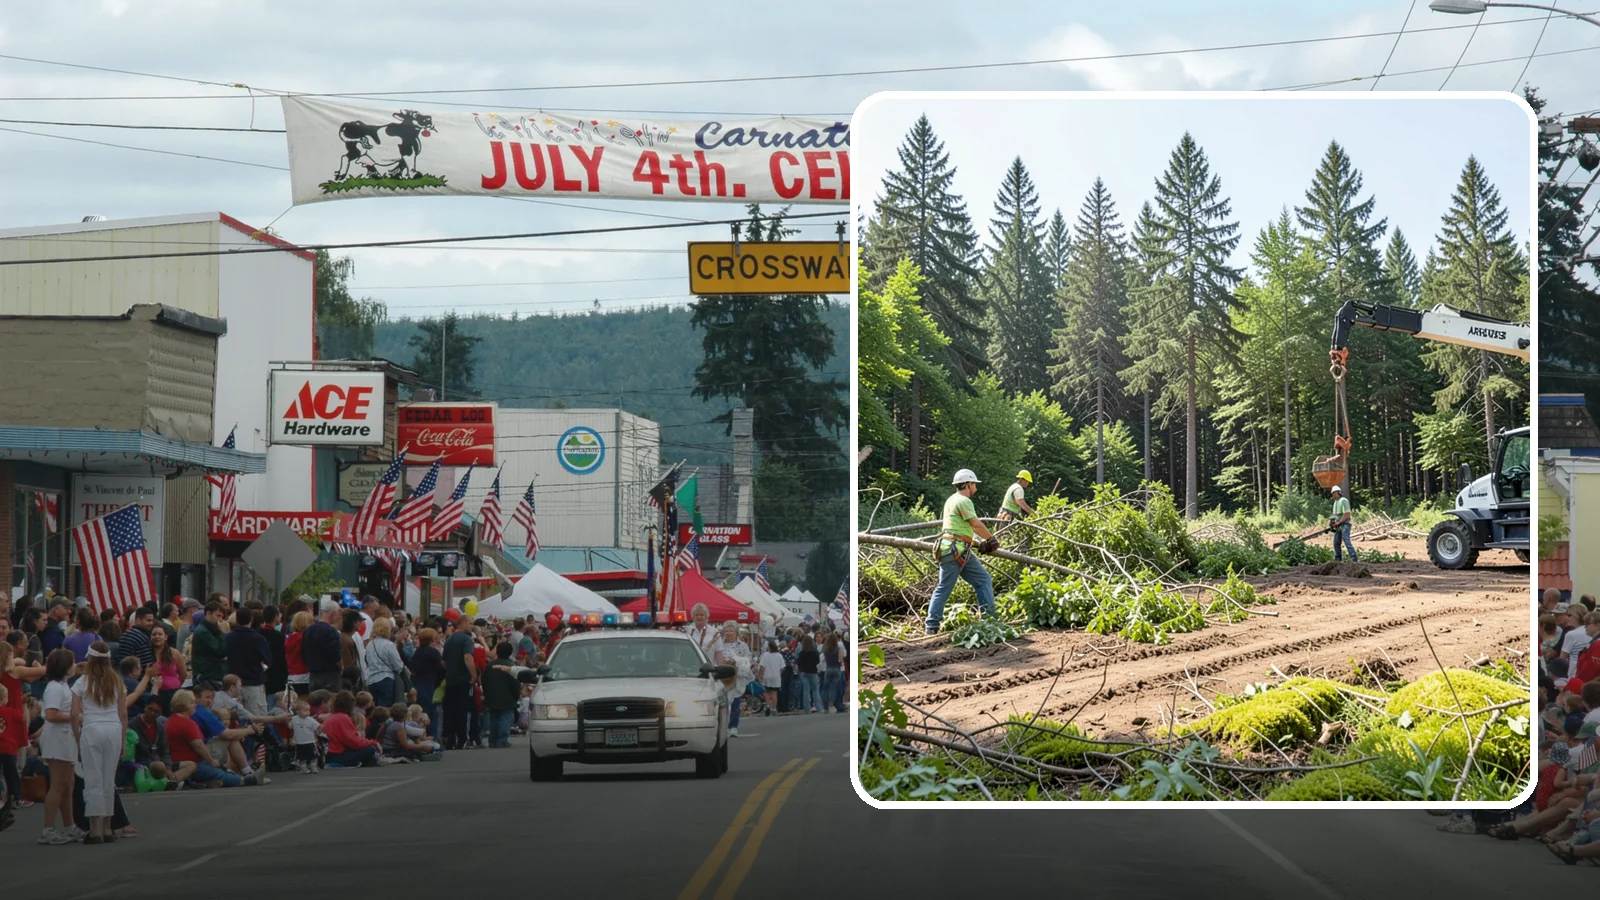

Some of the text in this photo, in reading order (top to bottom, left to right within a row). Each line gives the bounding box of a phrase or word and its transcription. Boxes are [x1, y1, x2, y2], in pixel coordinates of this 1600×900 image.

[694, 121, 850, 150] Carnat
[481, 141, 605, 192] JULY
[632, 150, 746, 198] 4th.
[696, 253, 850, 281] CROSSWA
[282, 380, 374, 420] ACE
[405, 409, 485, 422] CEDAR LOG
[283, 421, 371, 437] Hardware
[416, 427, 477, 447] Coca-Cola
[353, 467, 385, 479] Simpl
[95, 484, 124, 495] Vincent
[126, 486, 136, 495] de
[137, 485, 155, 496] Paul
[688, 526, 741, 535] CRNATION
[699, 535, 730, 543] GLASS
